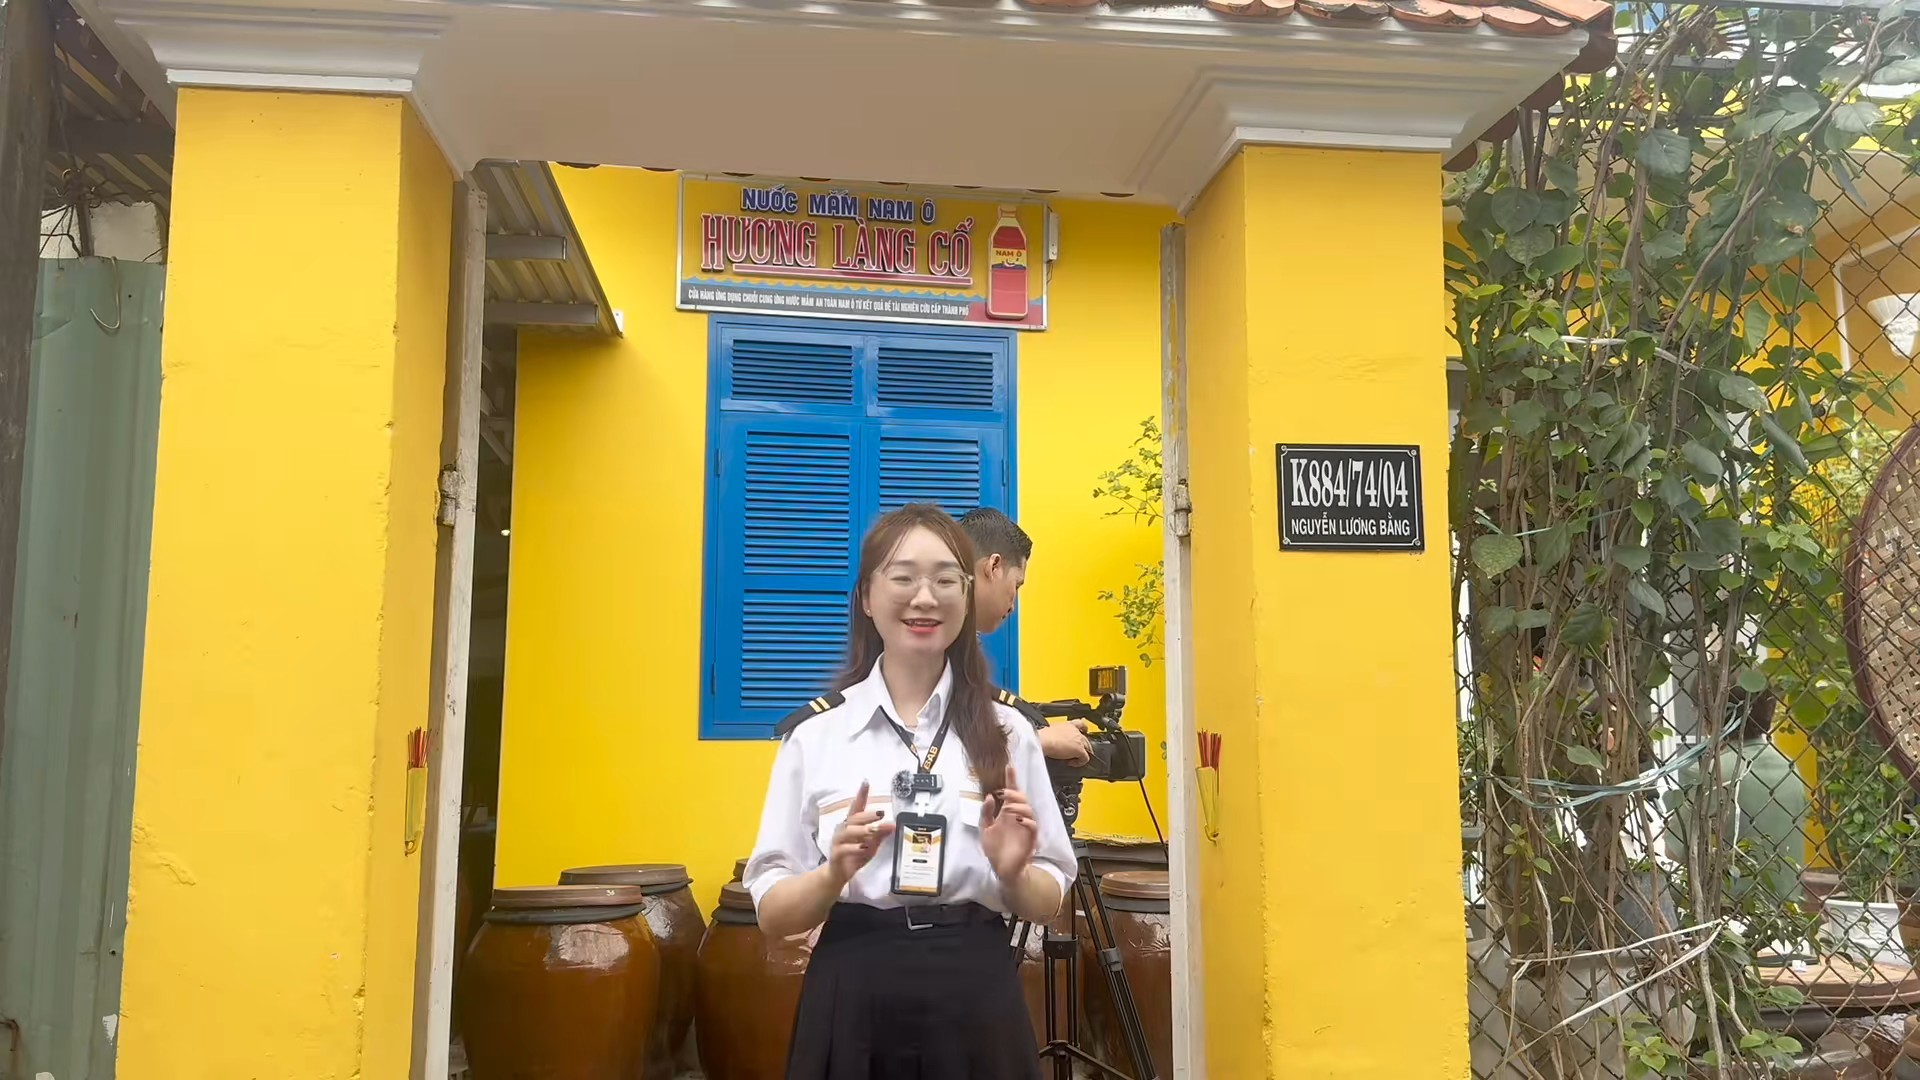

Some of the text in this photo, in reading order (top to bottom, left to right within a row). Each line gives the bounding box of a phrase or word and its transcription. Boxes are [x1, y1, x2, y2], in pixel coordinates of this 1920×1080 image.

[741, 184, 936, 223] NƯỚC MẮM NAM Ô
[701, 213, 975, 277] HƯƠNG LÀNG CỔ
[995, 249, 1022, 258] NAM Ô
[700, 289, 714, 301] HÀNG
[727, 292, 741, 304] DỤNG
[759, 294, 773, 304] CUNG
[816, 297, 823, 307] AN
[824, 297, 837, 308] TOÀN
[838, 298, 850, 309] NAM
[851, 298, 855, 309] Ô
[863, 299, 872, 310] KẾT
[892, 301, 900, 312] TÀI
[901, 301, 919, 312] NGHIÊN
[942, 304, 958, 315] THÀNH
[959, 305, 969, 316] PHỐ
[1290, 458, 1408, 508] K884/74/04
[1291, 512, 1410, 536] NGUYỄN LƯƠNG BẰNG
